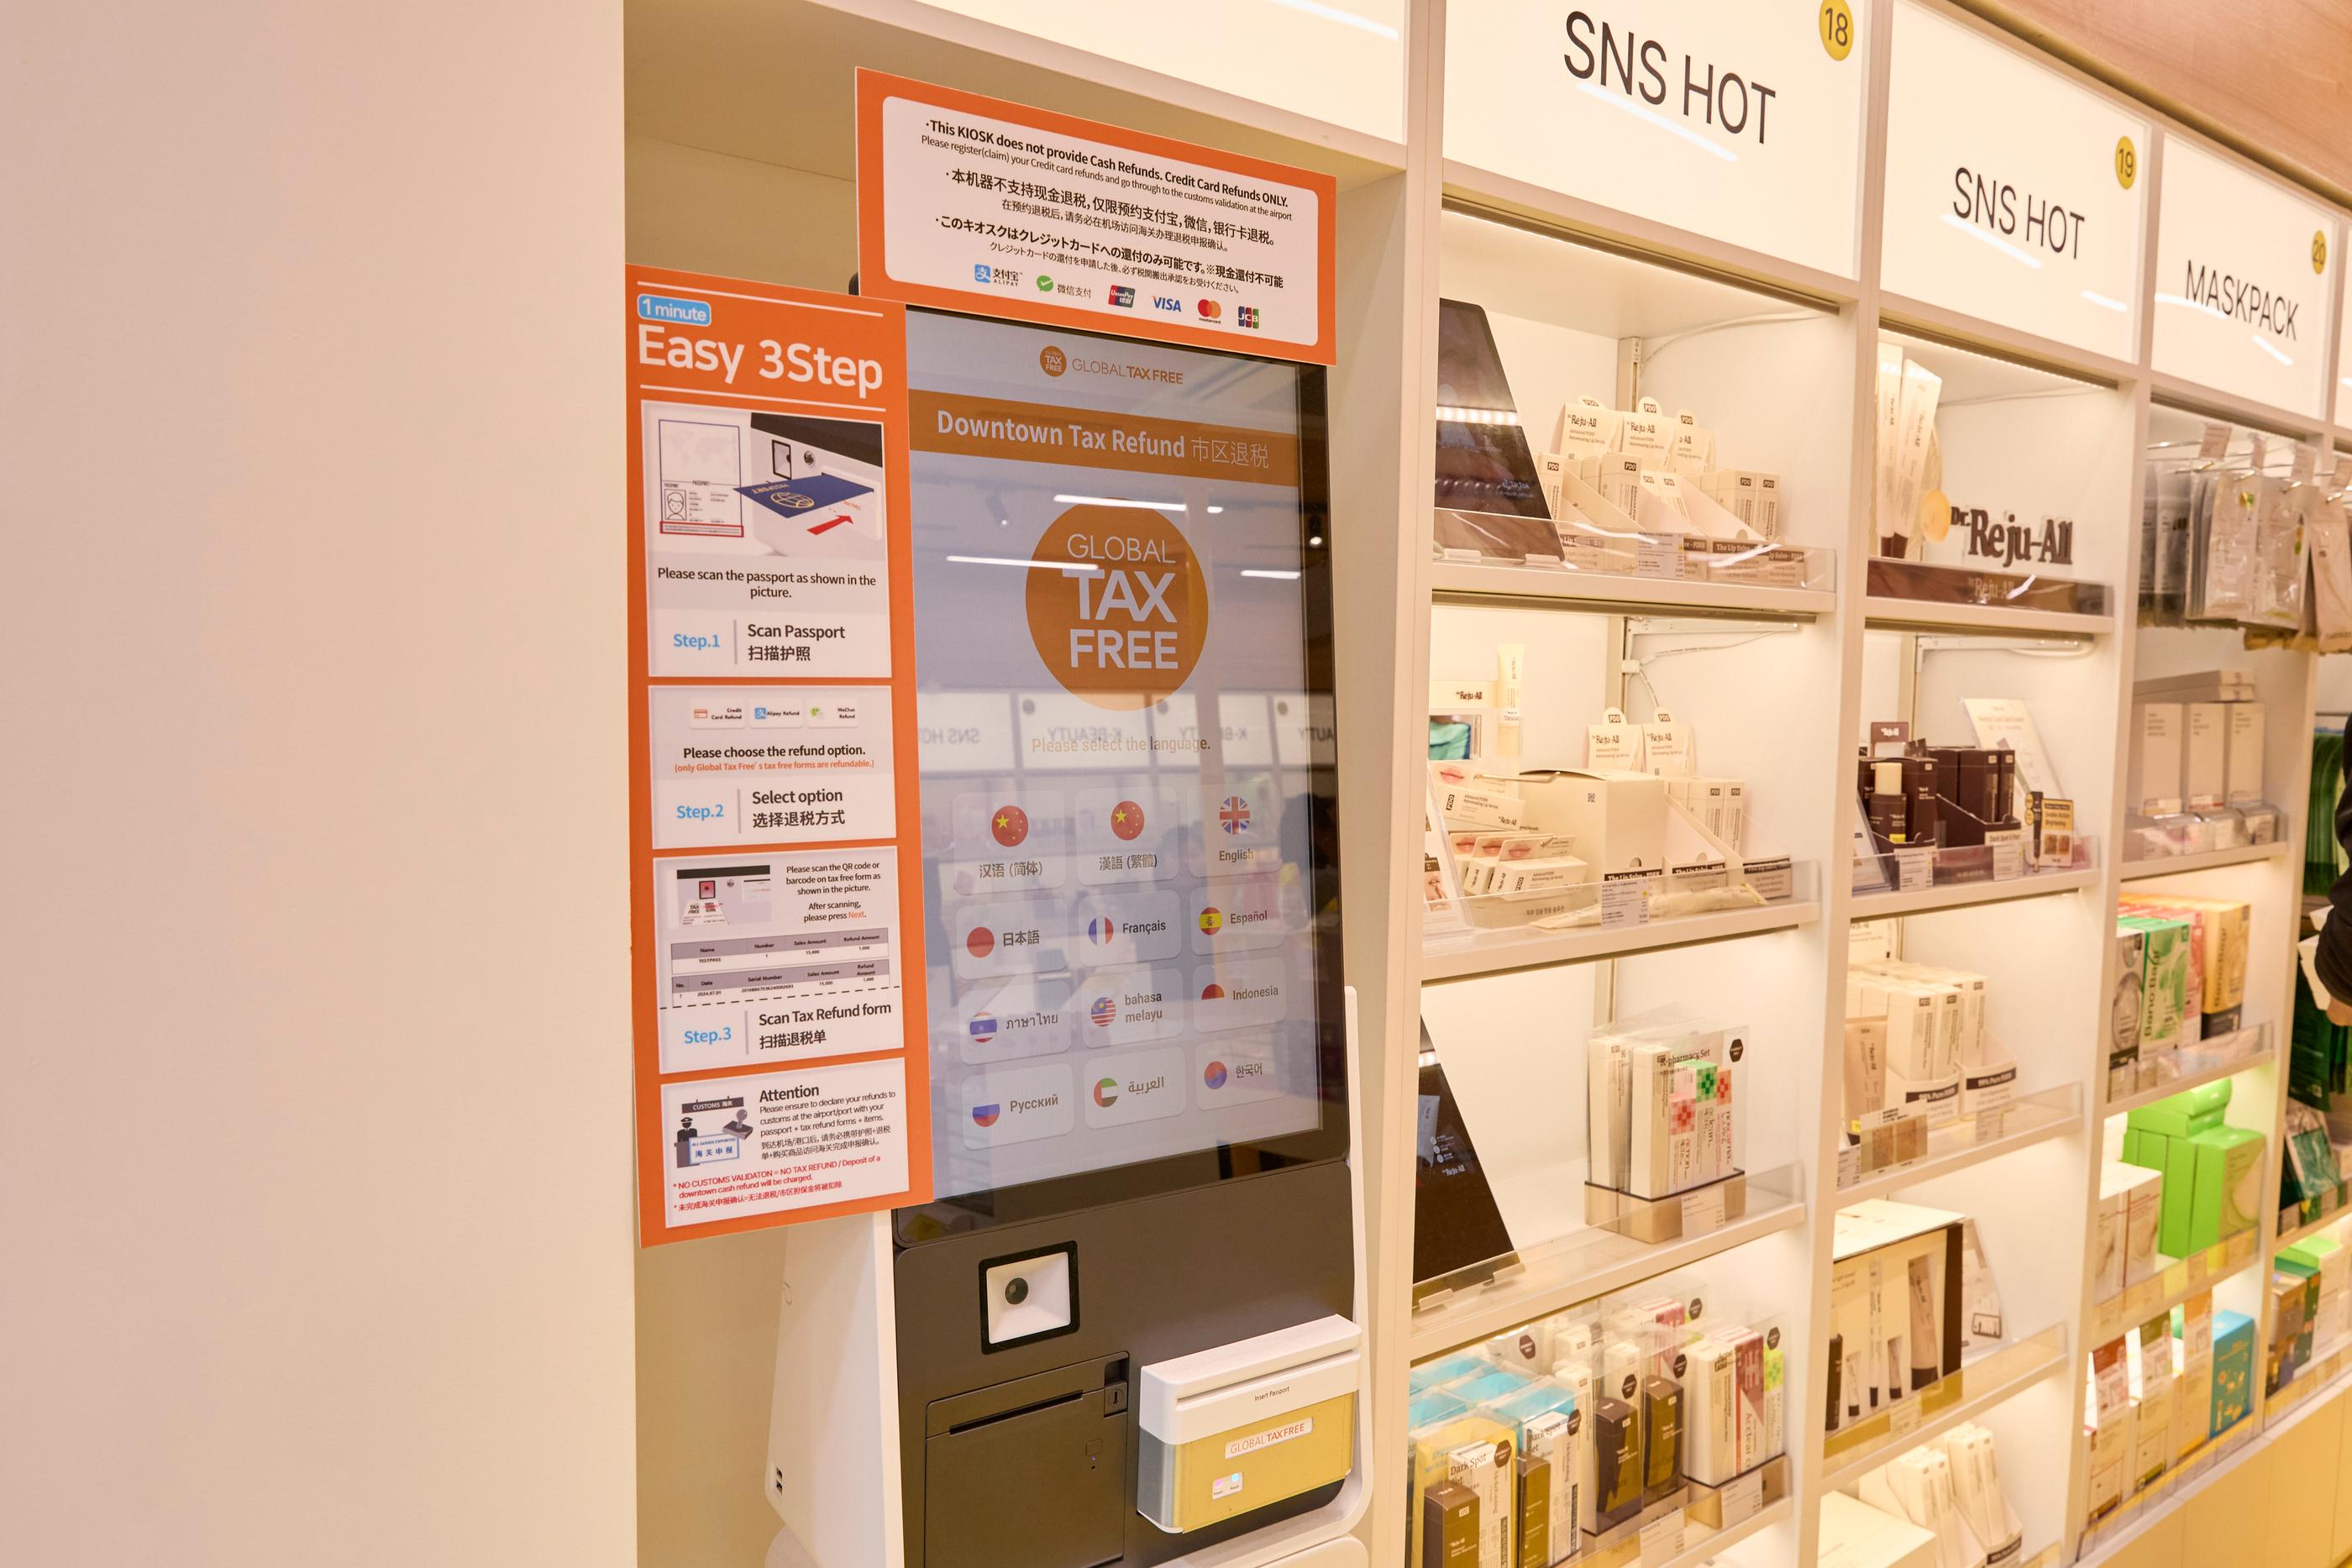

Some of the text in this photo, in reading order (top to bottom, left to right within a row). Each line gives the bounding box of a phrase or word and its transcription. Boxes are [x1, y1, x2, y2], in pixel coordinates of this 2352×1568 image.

[1825, 8, 1848, 47] 18
[1564, 11, 1776, 144] SNS HOT
[958, 126, 994, 144] KIOSK
[997, 135, 1023, 149] does
[1026, 142, 1044, 155] not
[1047, 146, 1088, 164] provide
[1091, 155, 1115, 170] Cash
[1119, 161, 1163, 181] Refunds.
[1165, 172, 1195, 187] Credit
[1198, 179, 1220, 192] Card
[1222, 184, 1260, 201] Refunds
[1263, 193, 1288, 207] ONLY.
[2118, 147, 2134, 178] 19
[921, 135, 949, 149] Please
[951, 141, 1010, 163] register(claim)
[1011, 155, 1030, 165] your
[1031, 159, 1054, 170] Credit
[1057, 164, 1073, 175] card
[1075, 168, 1104, 181] refunds
[1105, 175, 1119, 185] and
[1121, 178, 1130, 188] go
[1132, 181, 1161, 195] through
[1172, 188, 1183, 198] the
[1184, 192, 1213, 205] customs
[1215, 198, 1248, 212] validation
[1249, 205, 1256, 213] at
[1258, 206, 1268, 216] the
[1270, 208, 1292, 221] airport
[1953, 167, 2085, 260] SNS HOT
[2312, 239, 2326, 265] 20
[1057, 284, 1091, 298] 微信支付
[1152, 296, 1182, 312] VISA
[2187, 260, 2298, 341] MASKPACK
[642, 298, 707, 323] 1 minute
[1238, 313, 1258, 323] JCB
[638, 323, 883, 399] Easy 3Step
[1045, 356, 1062, 365] TAX
[1045, 364, 1063, 373] FREE
[1072, 358, 1184, 385] GLOBAL TAX FREE
[937, 410, 1269, 469] Downtown Tax Refund 市区退税
[1950, 506, 2072, 568] Dr. Reju-All
[1067, 533, 1176, 564] GLOBAL
[658, 567, 876, 586] Please scan the passport as shown in the
[750, 586, 791, 599] picture.
[1062, 568, 1178, 623] TAX
[748, 624, 845, 641] Scan Passport
[673, 633, 720, 650] Step.1
[1069, 628, 1179, 669] FREE
[748, 645, 811, 661] 扫描护照
[684, 745, 866, 758] Please choose the refund option.
[1032, 737, 1210, 754] Please select the language.
[753, 789, 843, 805] Select option
[676, 804, 724, 821] Step.2
[753, 810, 845, 829] 选择退税方式
[1099, 856, 1123, 870] 漢語
[1219, 848, 1254, 863] English
[786, 865, 809, 873] Please
[854, 862, 870, 870] code
[979, 861, 1042, 878] 汉语 (简体)
[786, 876, 815, 884] barcode
[840, 873, 853, 882] free
[798, 887, 822, 895] shown
[844, 884, 870, 894] picture.
[808, 900, 861, 910] After scanning,
[804, 910, 866, 923] please press Next.
[1230, 910, 1268, 925] Español
[1122, 920, 1166, 935] Français
[1003, 931, 1040, 947] 日本語
[1125, 992, 1162, 1006] bahasa
[1232, 985, 1278, 1000] Indonesia
[759, 1003, 891, 1026] Scan Tax Refund form
[1005, 1012, 1058, 1030] ภาษาไทย
[1126, 1009, 1163, 1024] melayu
[685, 1026, 732, 1045] Step.3
[759, 1030, 827, 1050] 扫描退税单
[1701, 1049, 1710, 1058] Set
[1235, 1062, 1263, 1078] 한국어
[1128, 1076, 1164, 1093] العربية
[759, 1085, 819, 1102] Attention
[692, 1102, 721, 1110] CUSTOMS
[1010, 1093, 1058, 1113] Русский
[1254, 1387, 1289, 1402] Insert Passport
[1230, 1424, 1305, 1454] GLOBAL TAX FREE
[1451, 1461, 1469, 1476] Dark
[1470, 1454, 1487, 1468] Spot
